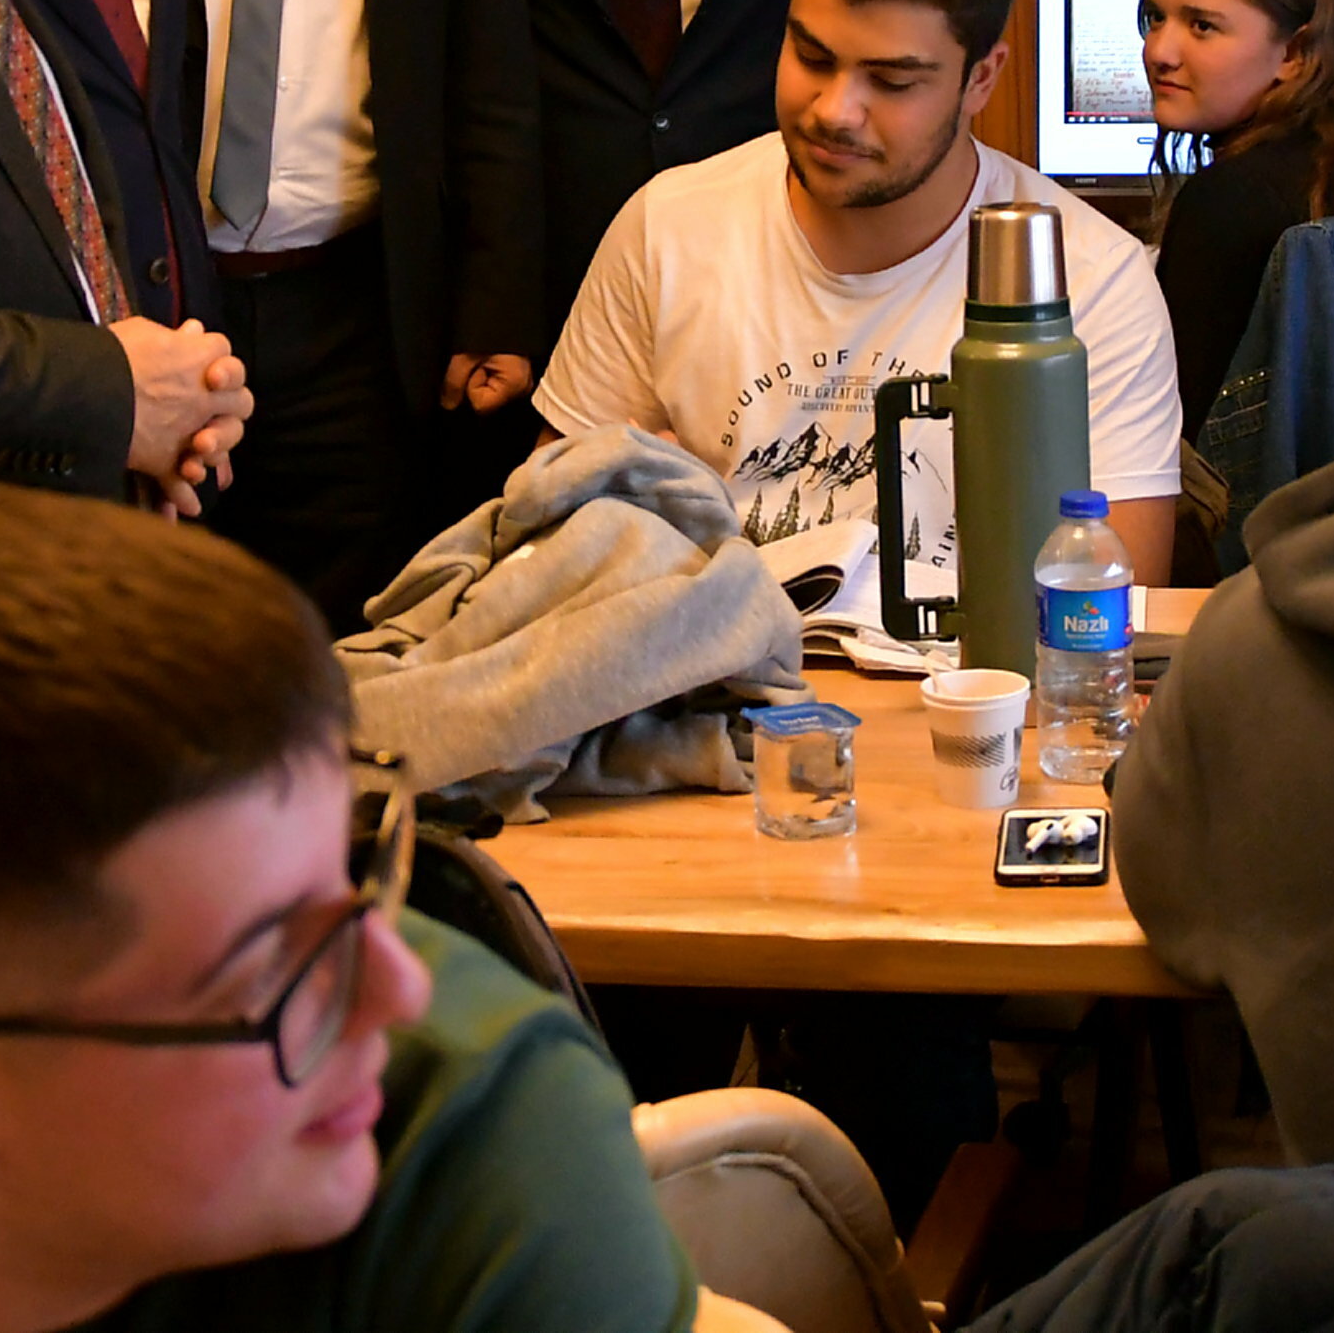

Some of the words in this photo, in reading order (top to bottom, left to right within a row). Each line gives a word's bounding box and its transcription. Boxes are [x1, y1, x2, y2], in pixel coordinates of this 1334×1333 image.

[721, 362, 792, 447] SOUND
[813, 350, 849, 368] OF
[786, 383, 810, 399] THE
[815, 385, 852, 400] GREAT
[1063, 615, 1109, 633] Nazlı
